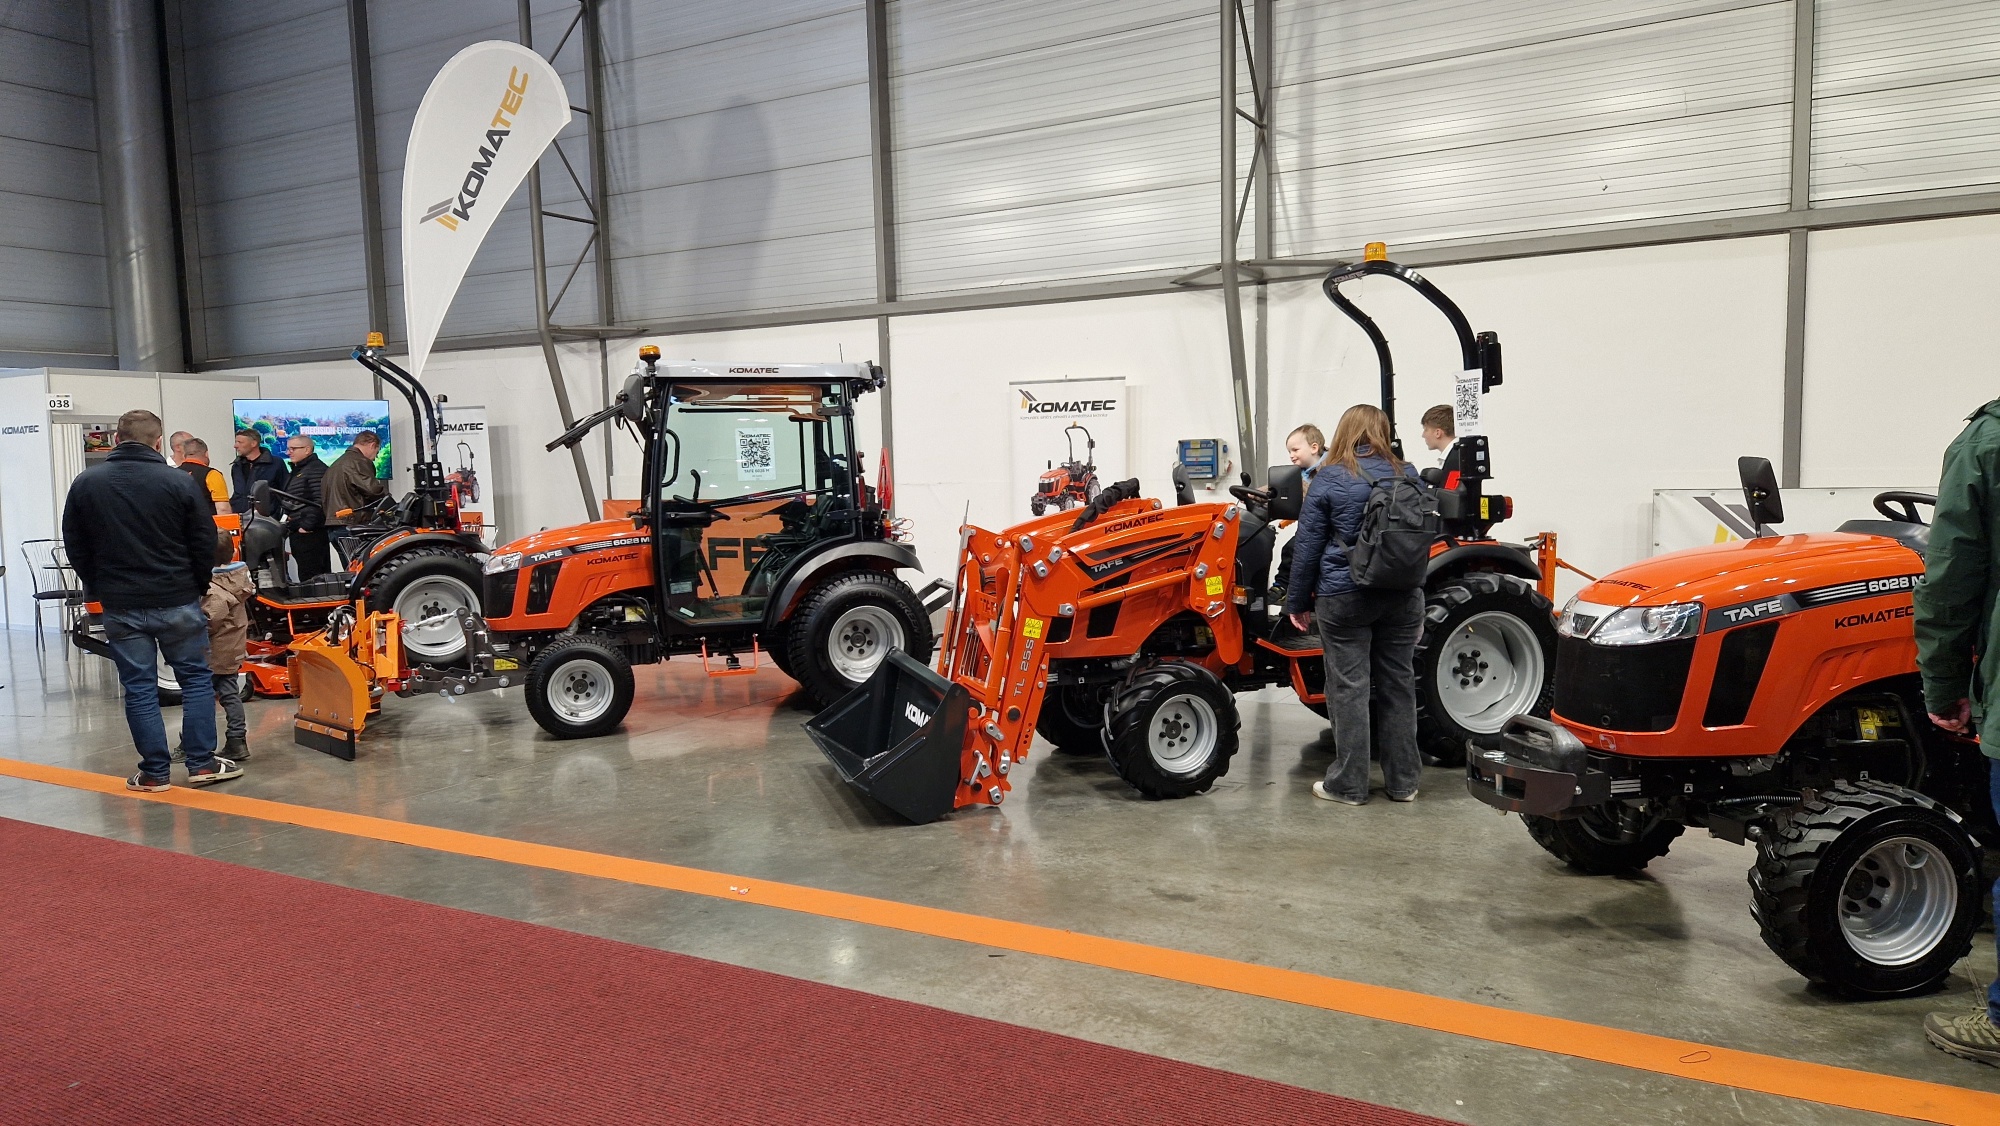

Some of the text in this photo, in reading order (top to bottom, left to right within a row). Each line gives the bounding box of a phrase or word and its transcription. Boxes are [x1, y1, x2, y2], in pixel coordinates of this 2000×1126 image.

[453, 65, 529, 221] KOMATEC
[729, 367, 779, 375] KOMATEC
[49, 399, 70, 408] 038
[1028, 400, 1117, 413] KOMATEC
[2, 425, 39, 435] KOMATEC
[300, 426, 336, 435] PRECISION
[443, 423, 484, 432] OMATEC
[1104, 513, 1164, 534] KOMATEC
[613, 538, 639, 546] 6028
[531, 550, 562, 562] TAFE
[587, 553, 639, 565] KOMATEC
[1091, 558, 1123, 573] TAFE
[1868, 576, 1909, 592] 6028
[1723, 600, 1783, 622] TAFE
[1834, 606, 1915, 629] KOMATEC
[1013, 678, 1025, 697] TL
